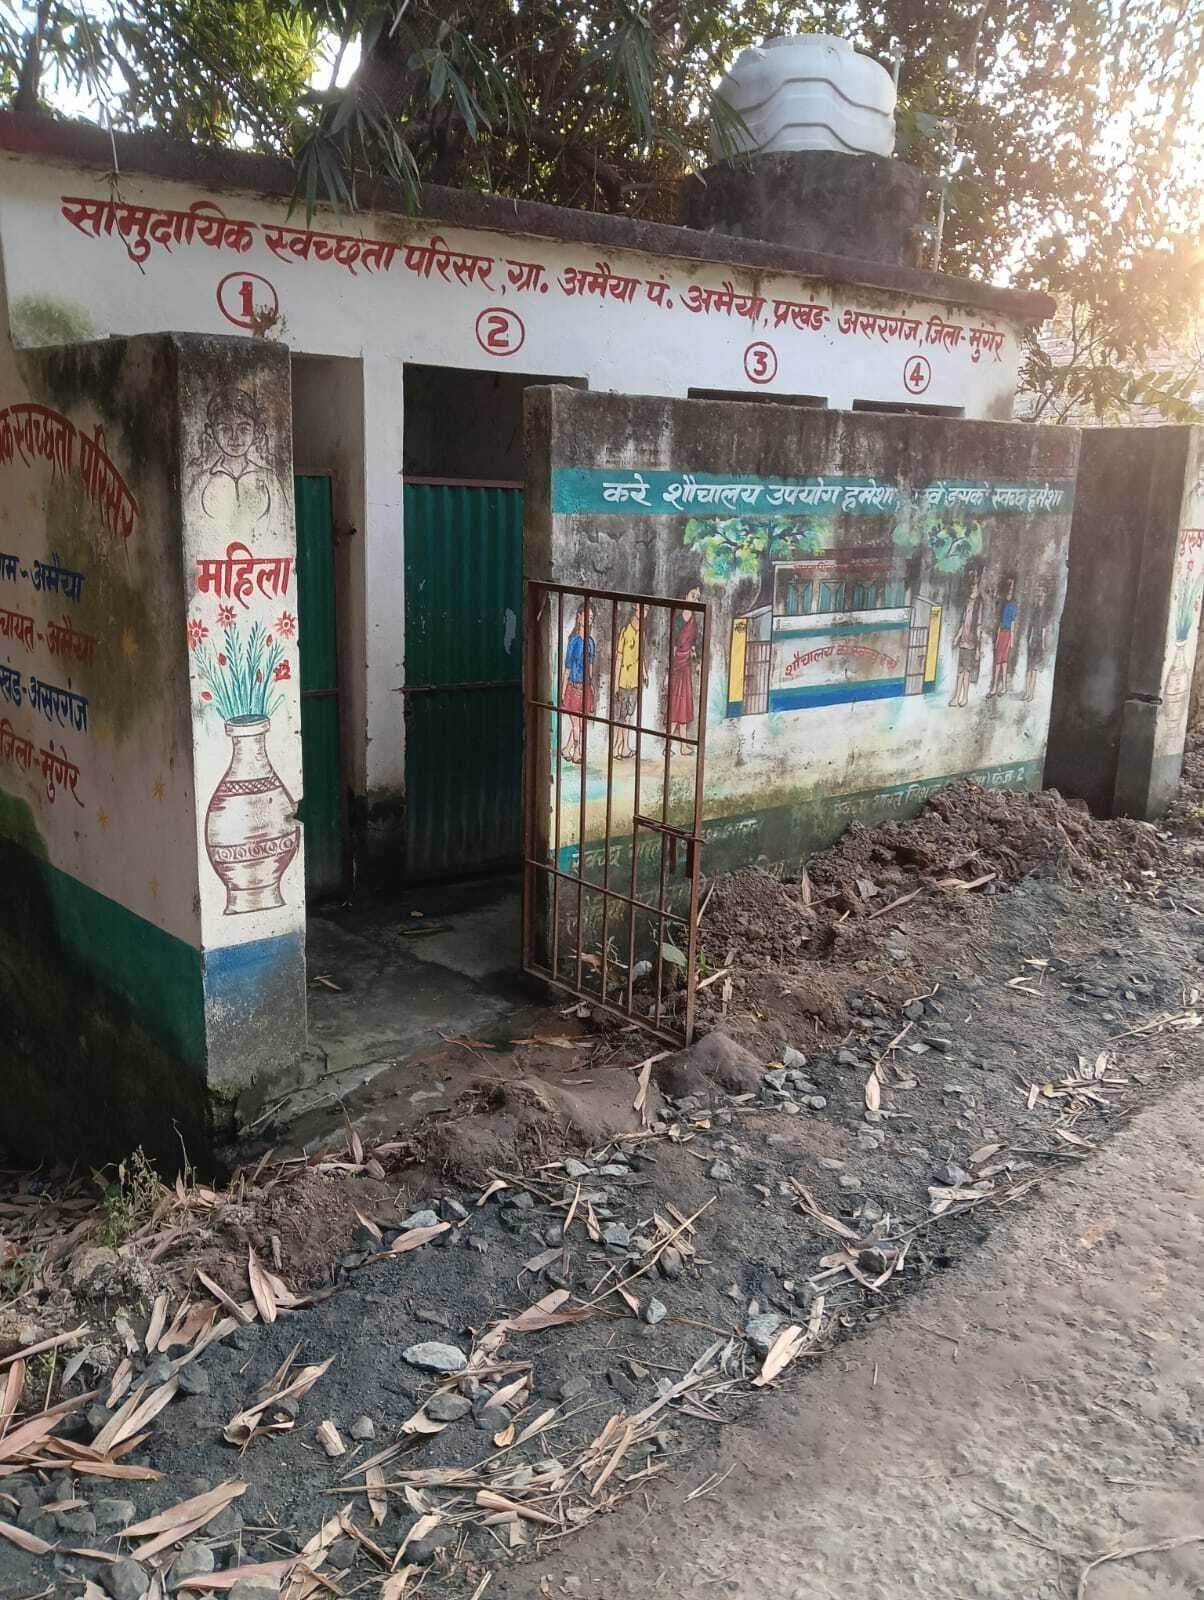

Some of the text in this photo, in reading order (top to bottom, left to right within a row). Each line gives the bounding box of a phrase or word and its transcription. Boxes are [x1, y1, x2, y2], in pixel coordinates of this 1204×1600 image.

[61, 196, 259, 263] सामुदायिक
[261, 223, 401, 276] स्वच्छता
[557, 262, 642, 303] अमैया
[487, 315, 509, 347] 2
[753, 350, 768, 376] 3
[909, 362, 924, 387] 4
[602, 472, 651, 507] करे
[662, 474, 765, 511] शौचालय
[766, 477, 843, 505] उपयोग
[196, 541, 293, 609] महिला
